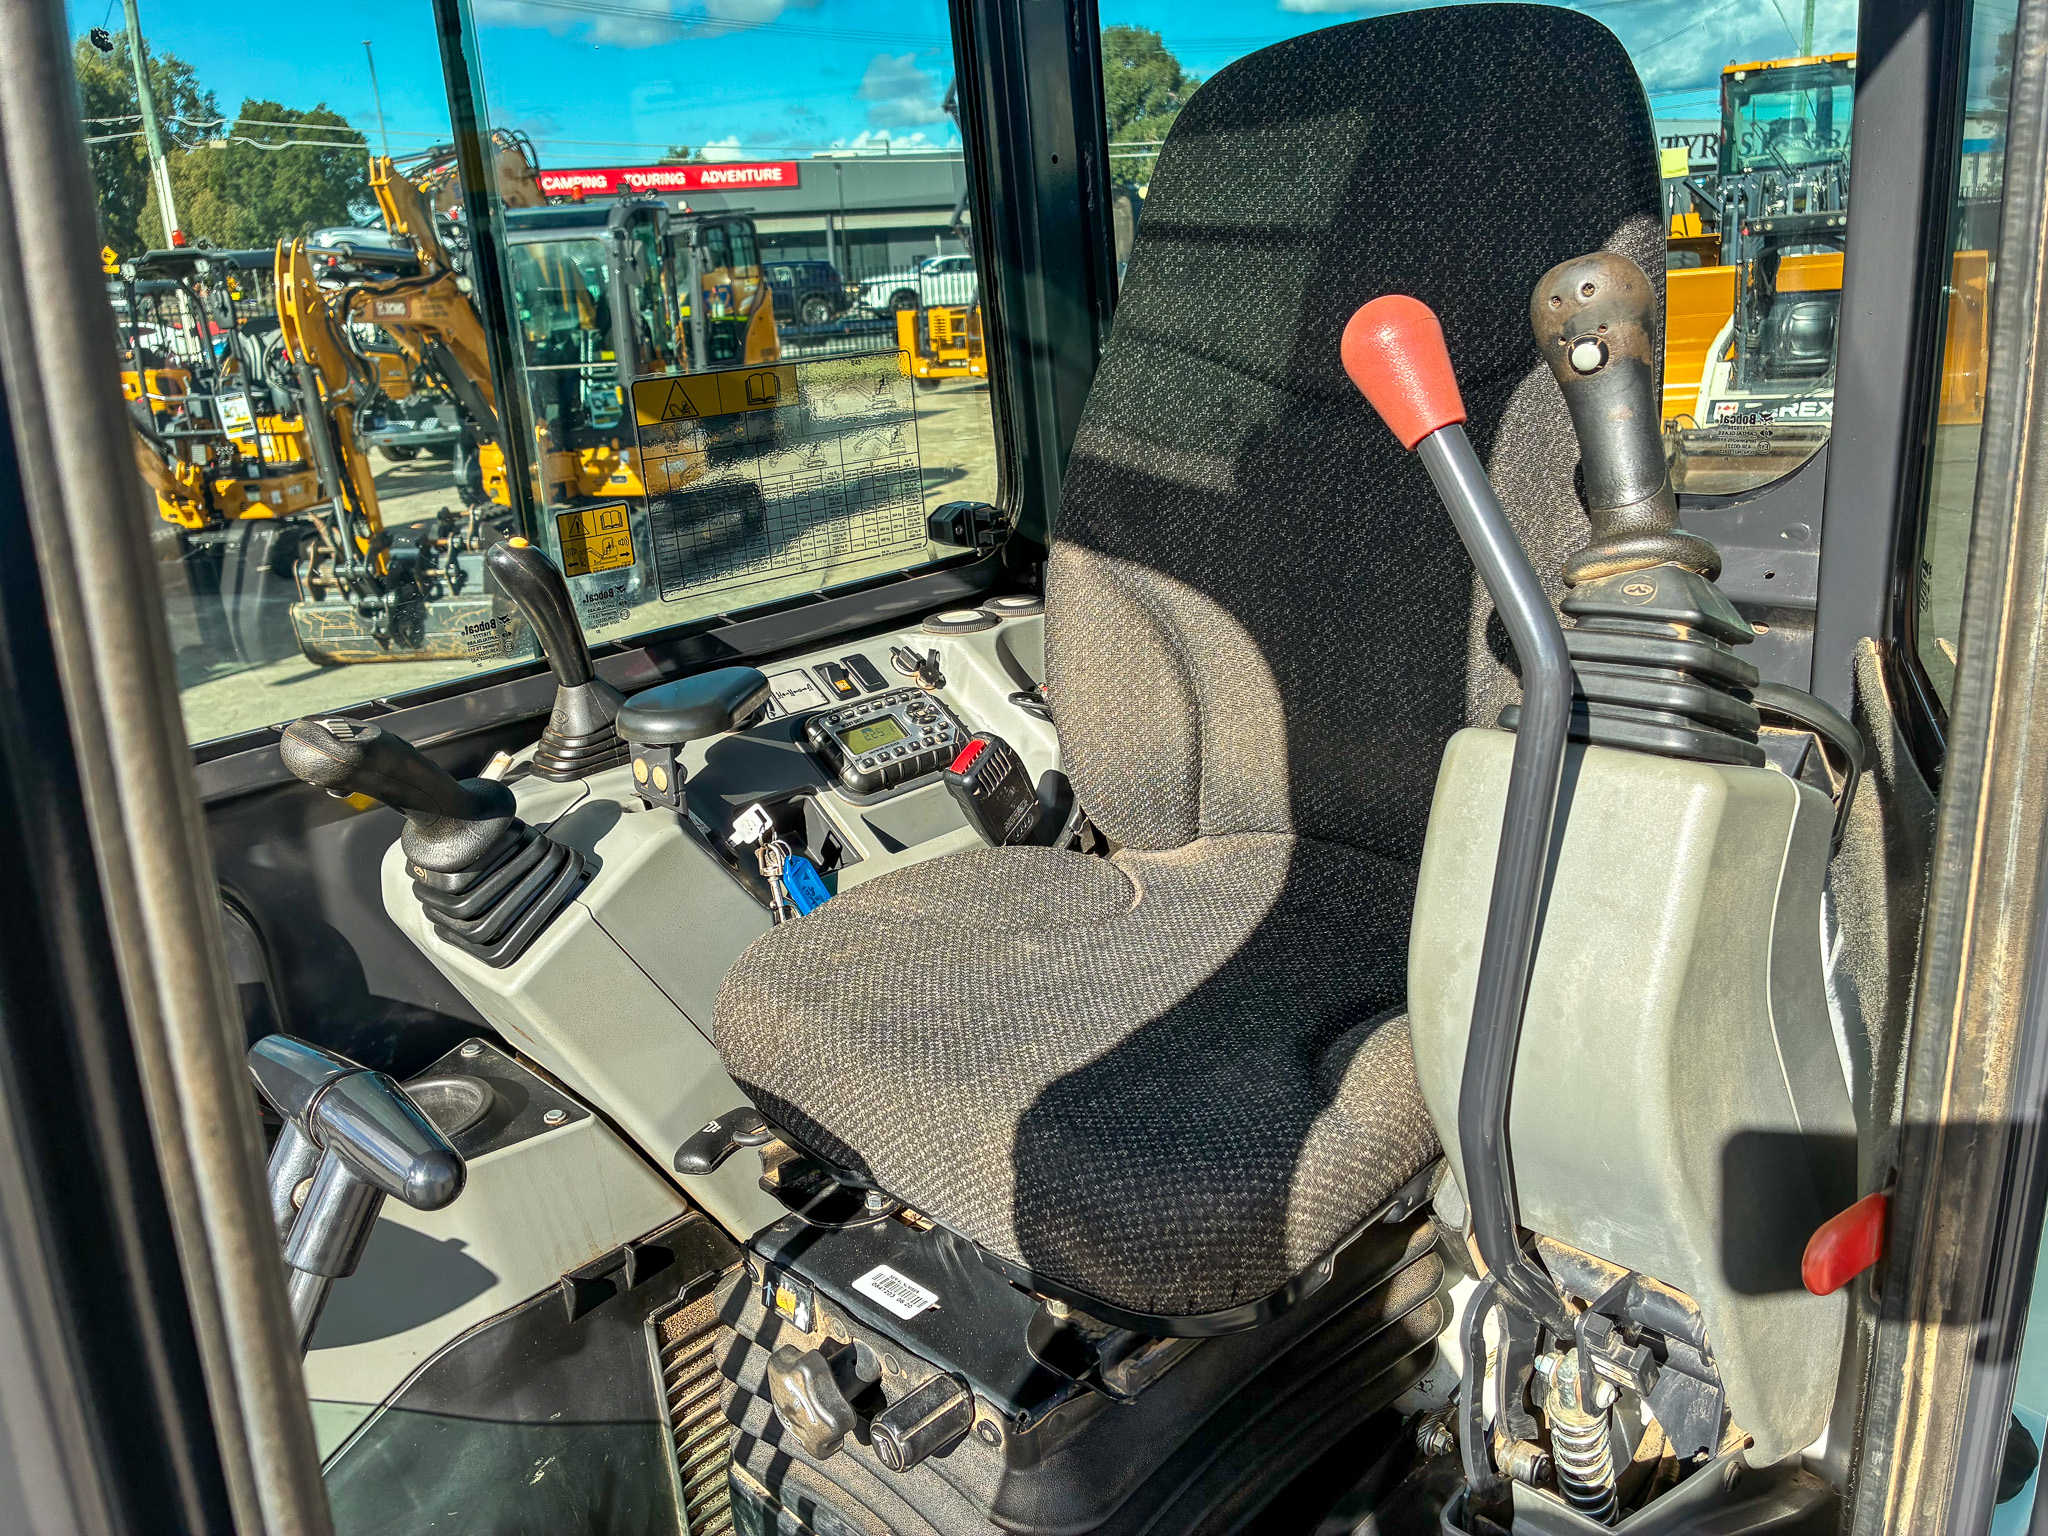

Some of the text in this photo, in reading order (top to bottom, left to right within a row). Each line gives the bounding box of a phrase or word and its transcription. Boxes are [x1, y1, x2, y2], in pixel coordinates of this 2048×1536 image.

[542, 168, 783, 189] CAMPING TOURING ADVENTURE
